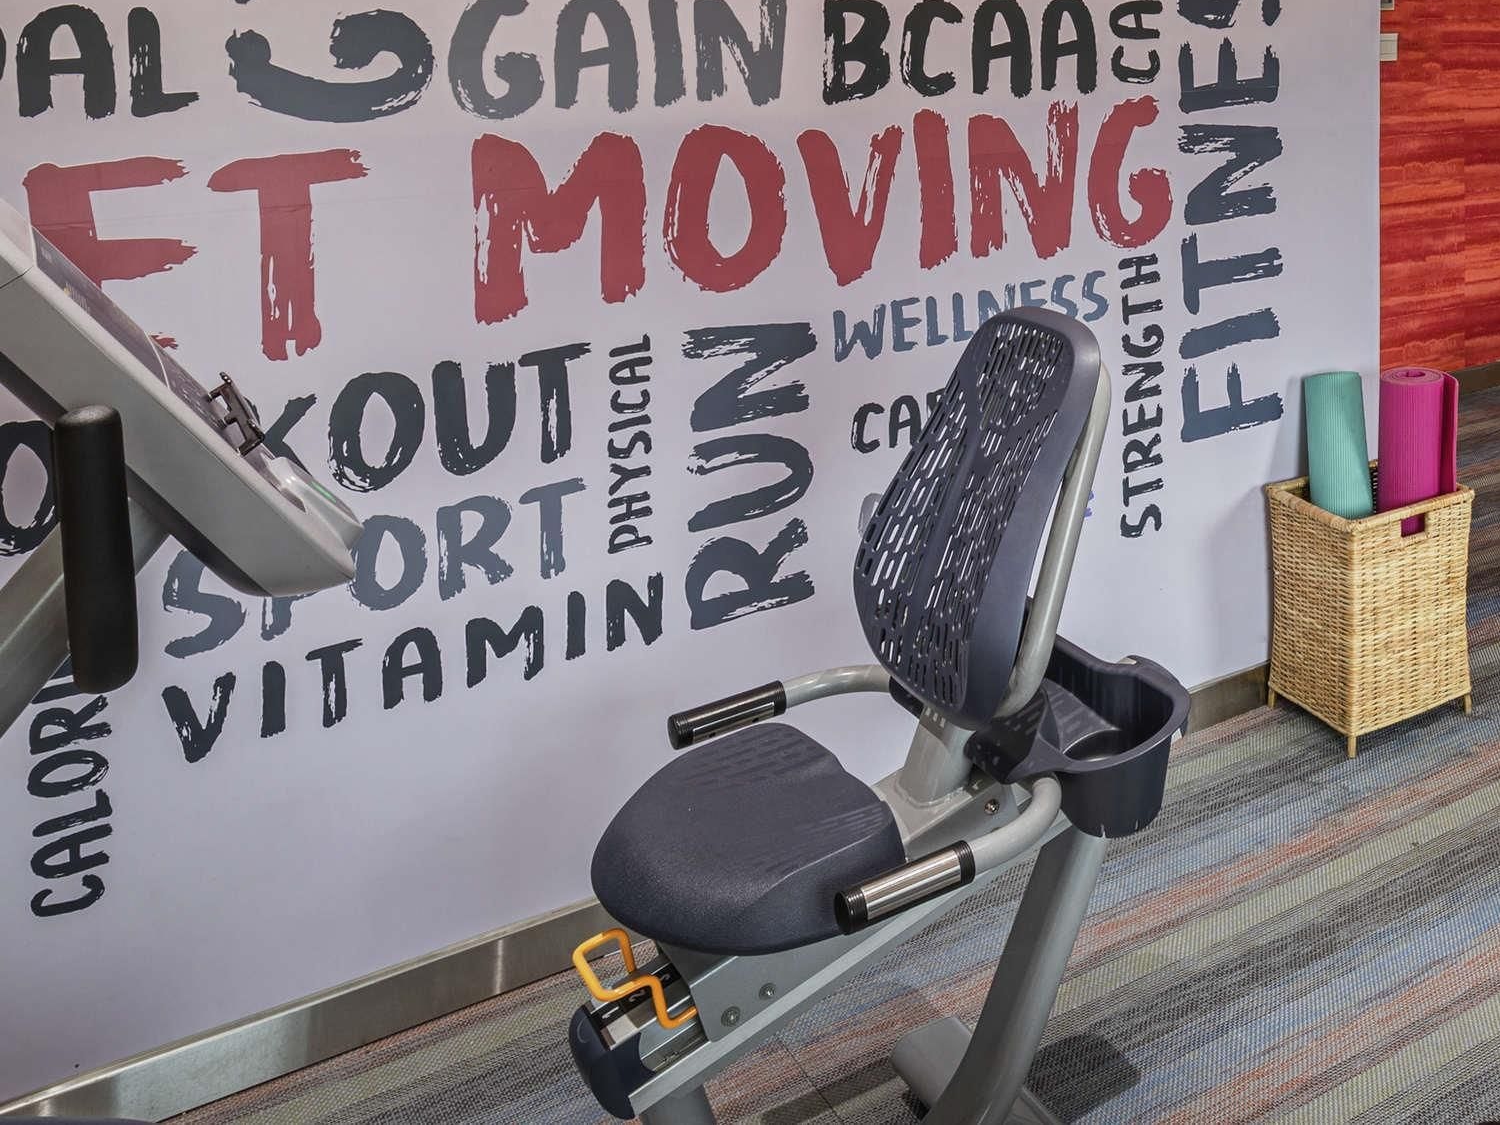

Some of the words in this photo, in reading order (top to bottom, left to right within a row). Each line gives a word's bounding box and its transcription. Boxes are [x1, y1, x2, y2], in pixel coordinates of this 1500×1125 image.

[0, 4, 199, 119] AL
[471, 95, 1173, 325] MOVING
[833, 271, 1109, 362] WELLNESS
[607, 333, 653, 554] PHYSICAL
[682, 322, 817, 630] RUN
[1117, 252, 1164, 539] STRENGTH
[162, 572, 664, 763] VITAMIN
[27, 654, 112, 917] CALORI
